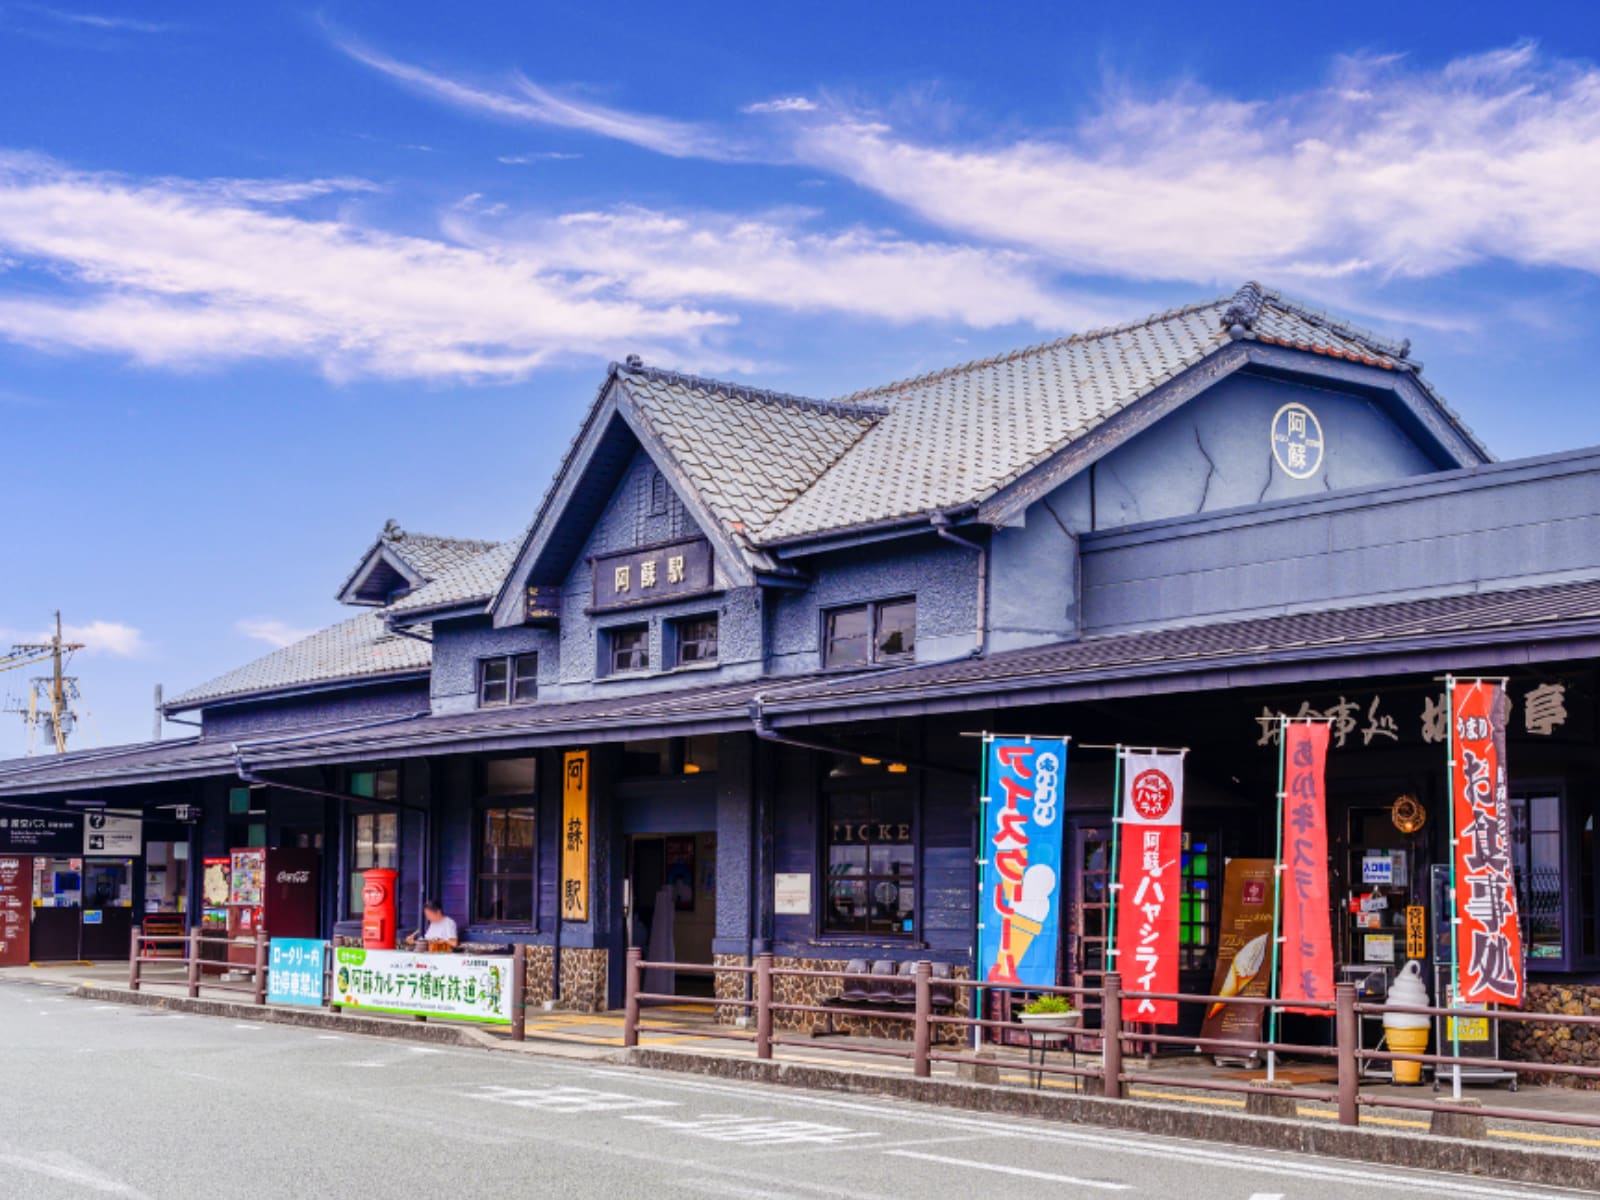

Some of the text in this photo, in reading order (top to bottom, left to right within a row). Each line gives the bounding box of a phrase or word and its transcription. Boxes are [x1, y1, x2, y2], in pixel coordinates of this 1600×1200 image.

[1287, 410, 1307, 471] 阿蘇
[614, 555, 685, 593] 阿蘇駅
[566, 757, 585, 911] 阿蘇駅
[1462, 749, 1519, 998] お食事処
[1134, 831, 1165, 1013] 阿蘇ハヤシライス
[1408, 907, 1424, 956] 営業中
[273, 946, 321, 968] ロータリー内
[269, 969, 321, 998] 駐停車禁止
[351, 968, 477, 1005] 阿蘇カルデラ横断鉄道
